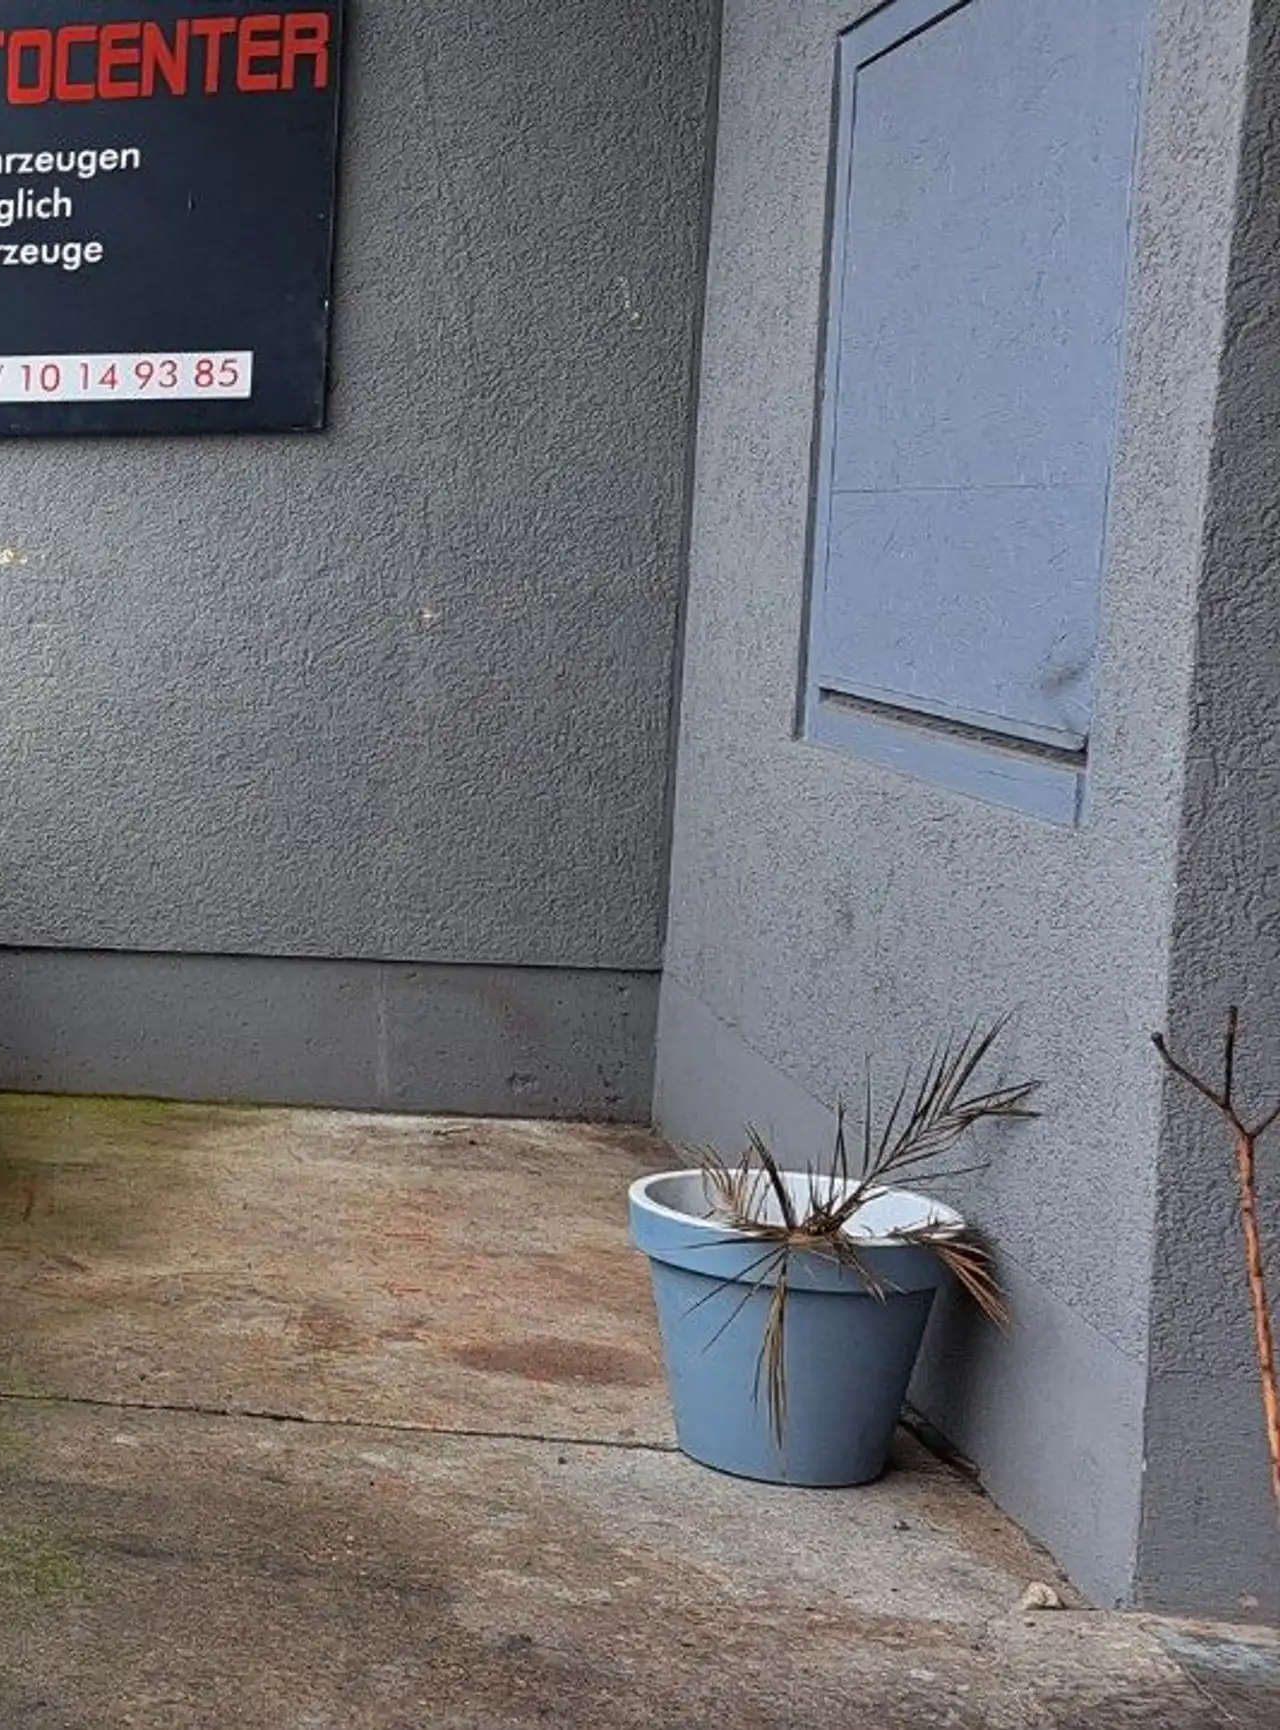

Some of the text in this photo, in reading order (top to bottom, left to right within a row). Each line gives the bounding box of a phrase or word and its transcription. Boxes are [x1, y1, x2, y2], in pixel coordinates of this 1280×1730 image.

[21, 362, 61, 392] 10
[79, 362, 119, 390] 14
[135, 360, 179, 390] 93
[194, 357, 239, 388] 85
